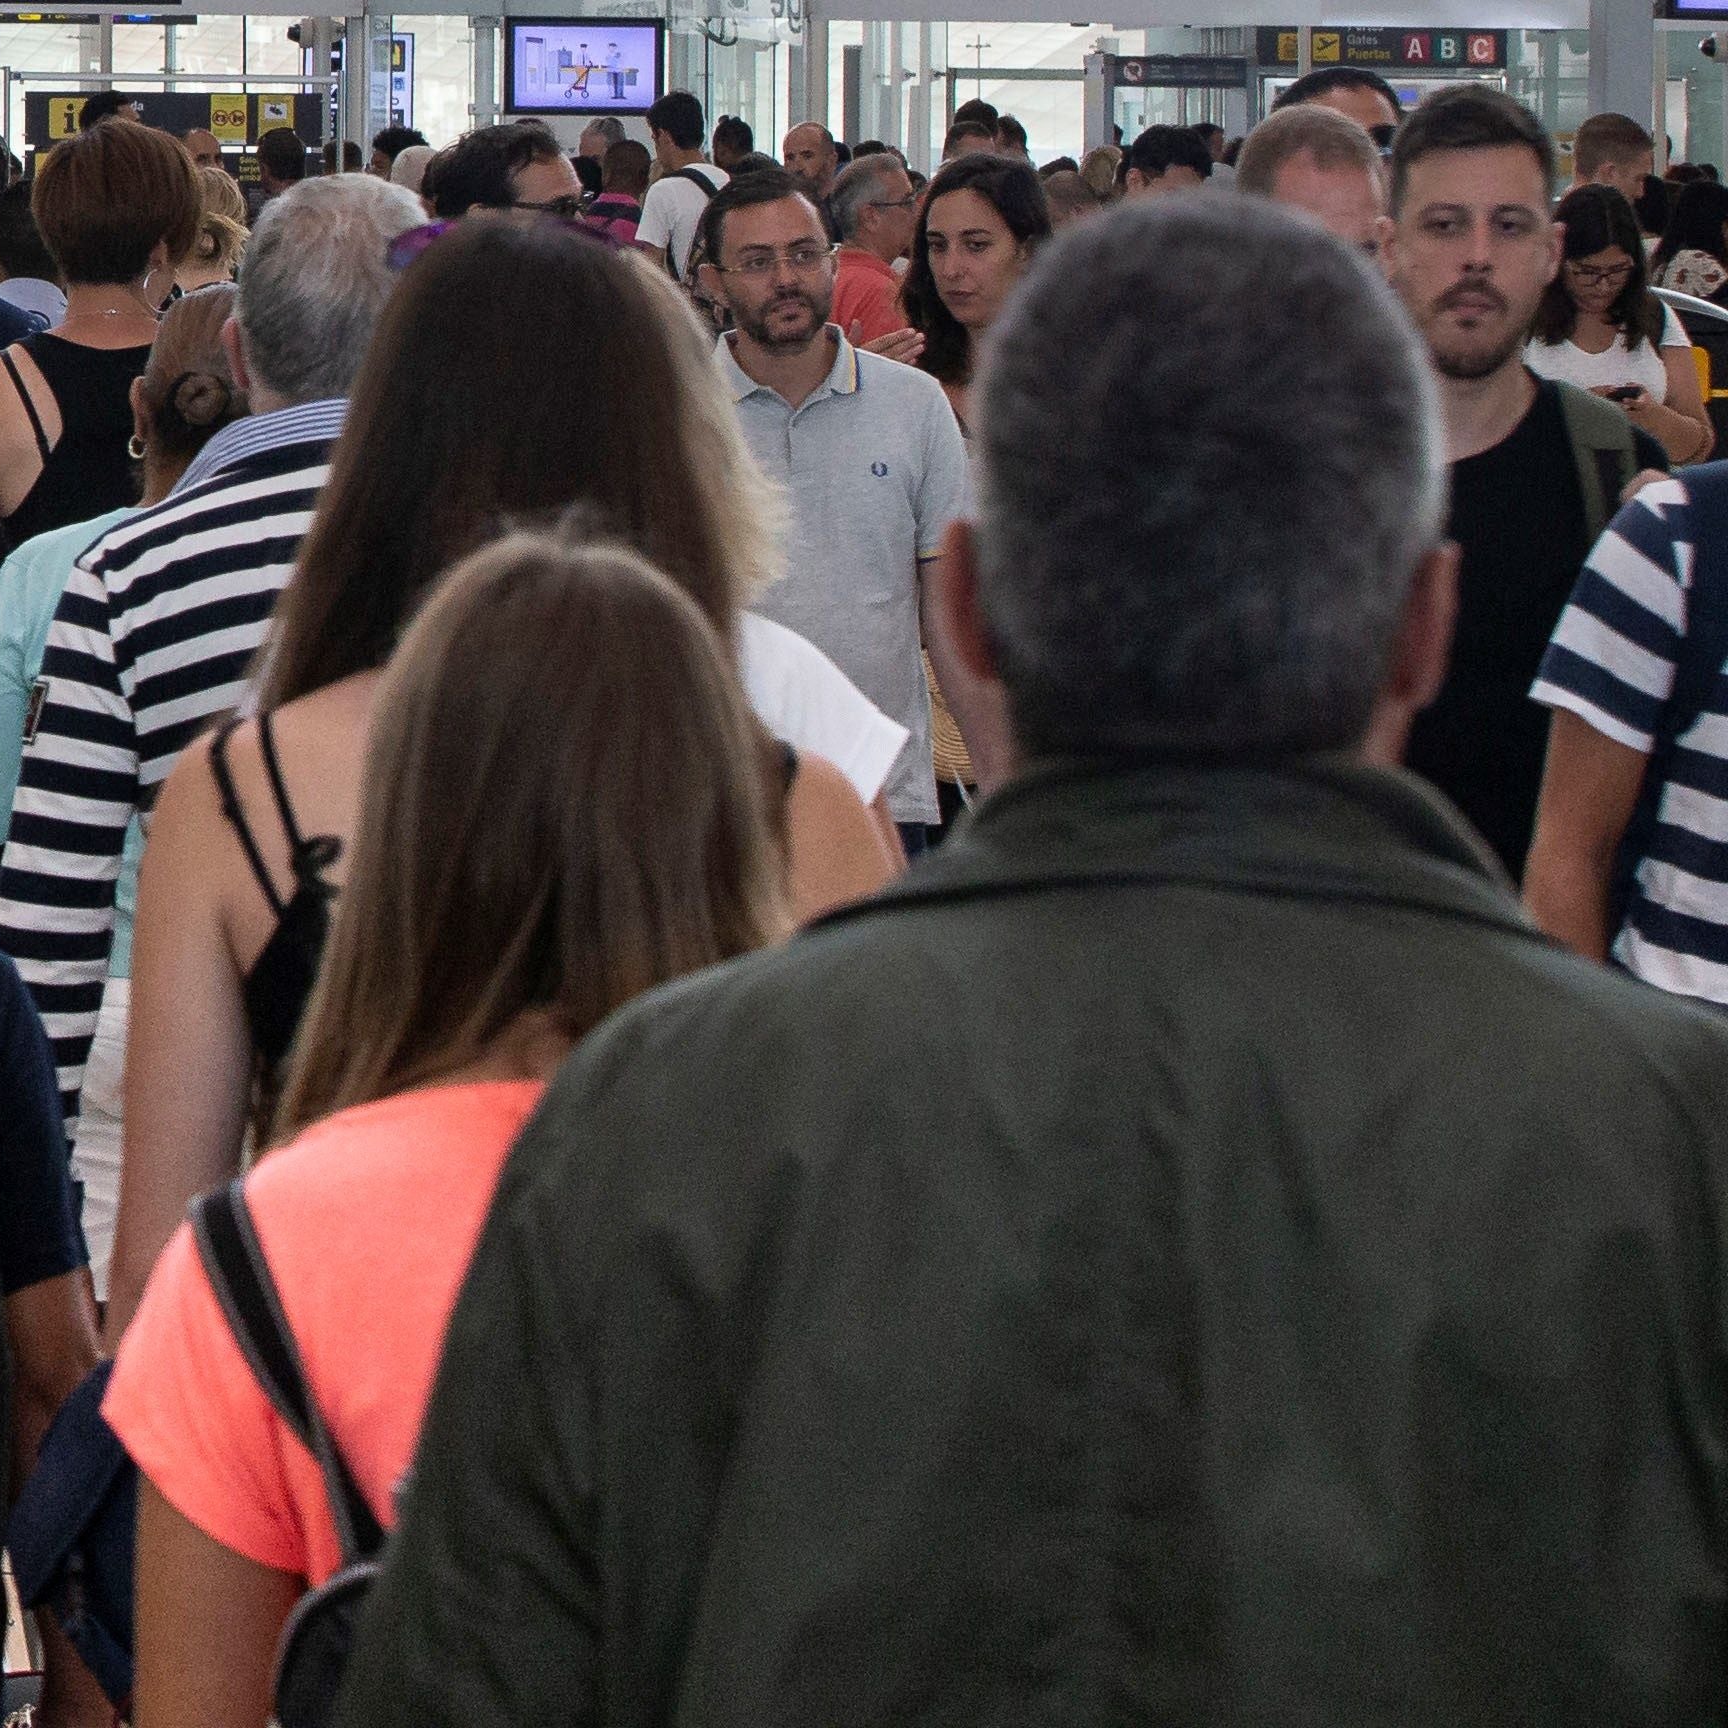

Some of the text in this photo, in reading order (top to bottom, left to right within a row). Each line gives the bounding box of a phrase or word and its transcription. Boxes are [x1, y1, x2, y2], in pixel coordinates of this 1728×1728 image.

[1347, 34, 1378, 45] Gates
[1348, 46, 1390, 59] Puertas
[1408, 39, 1489, 58] A B C
